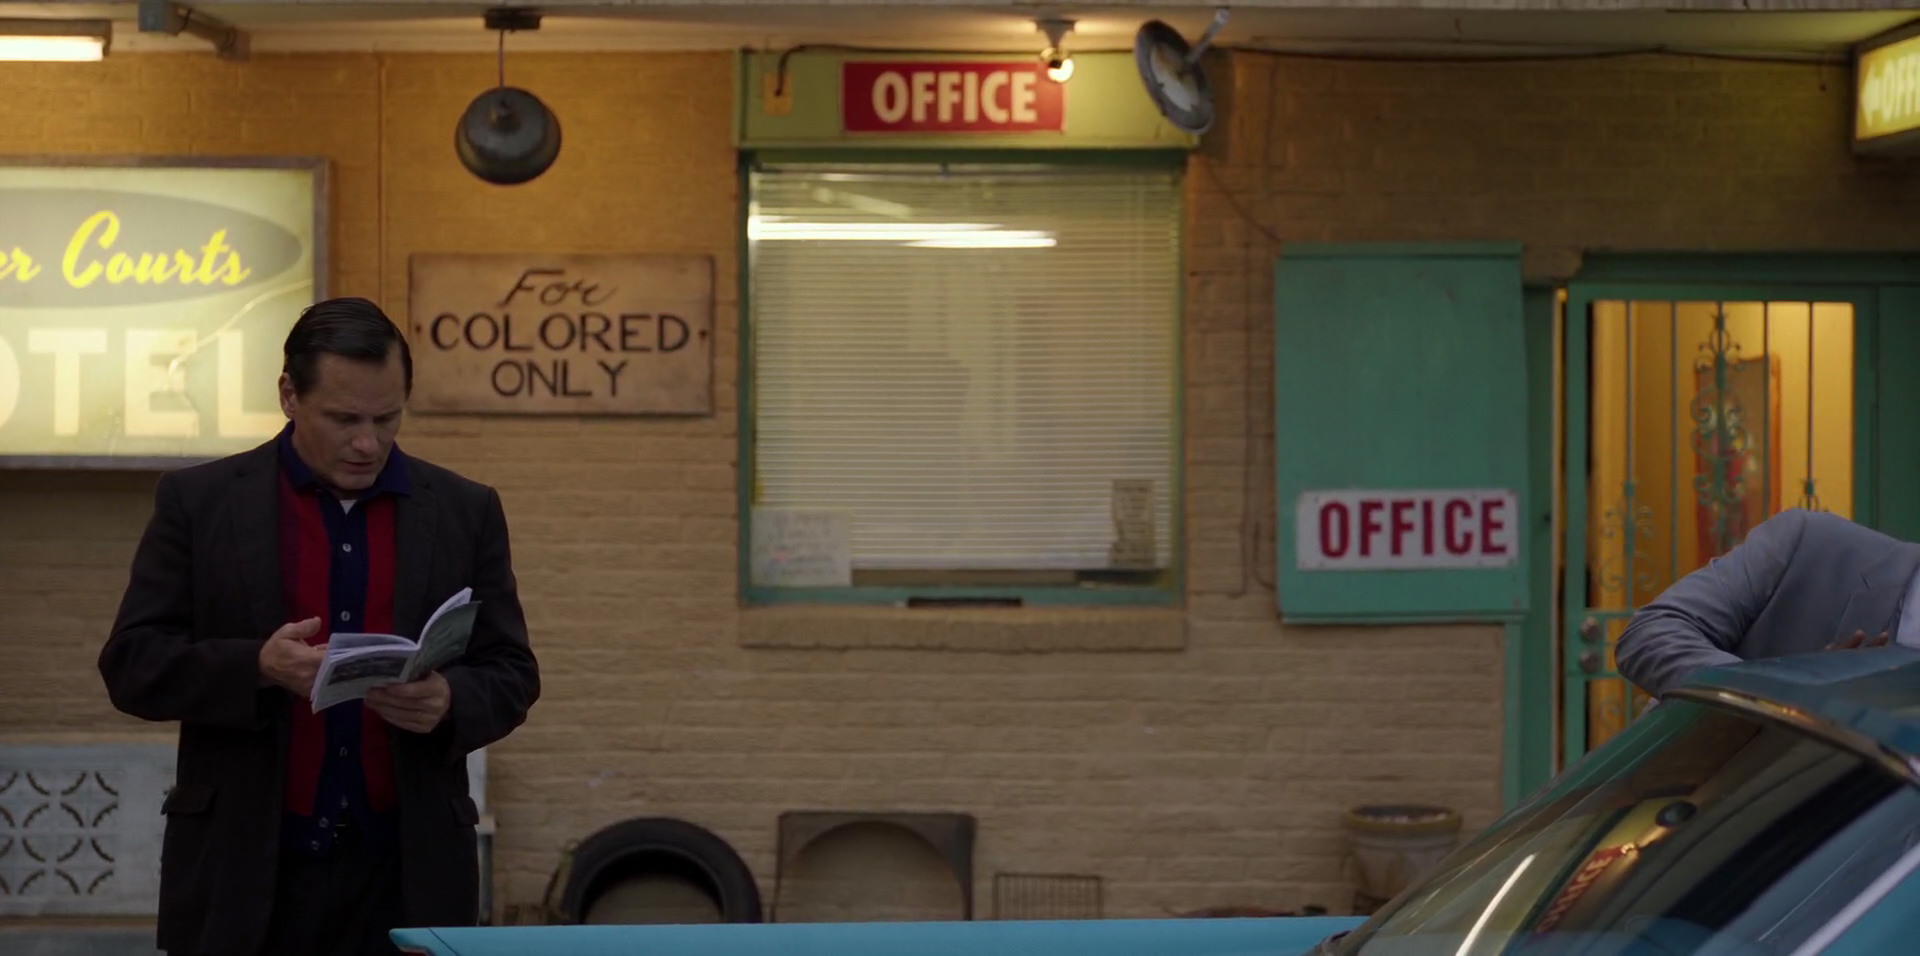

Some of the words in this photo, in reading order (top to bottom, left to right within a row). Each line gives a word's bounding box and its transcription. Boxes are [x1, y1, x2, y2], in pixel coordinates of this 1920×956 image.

[873, 71, 1037, 123] OFFICE
[62, 210, 250, 288] Courts
[497, 269, 617, 308] For
[431, 313, 689, 352] COLORED
[0, 328, 288, 438] TEL
[491, 359, 628, 398] ONLY
[1320, 498, 1507, 560] OFFICE
